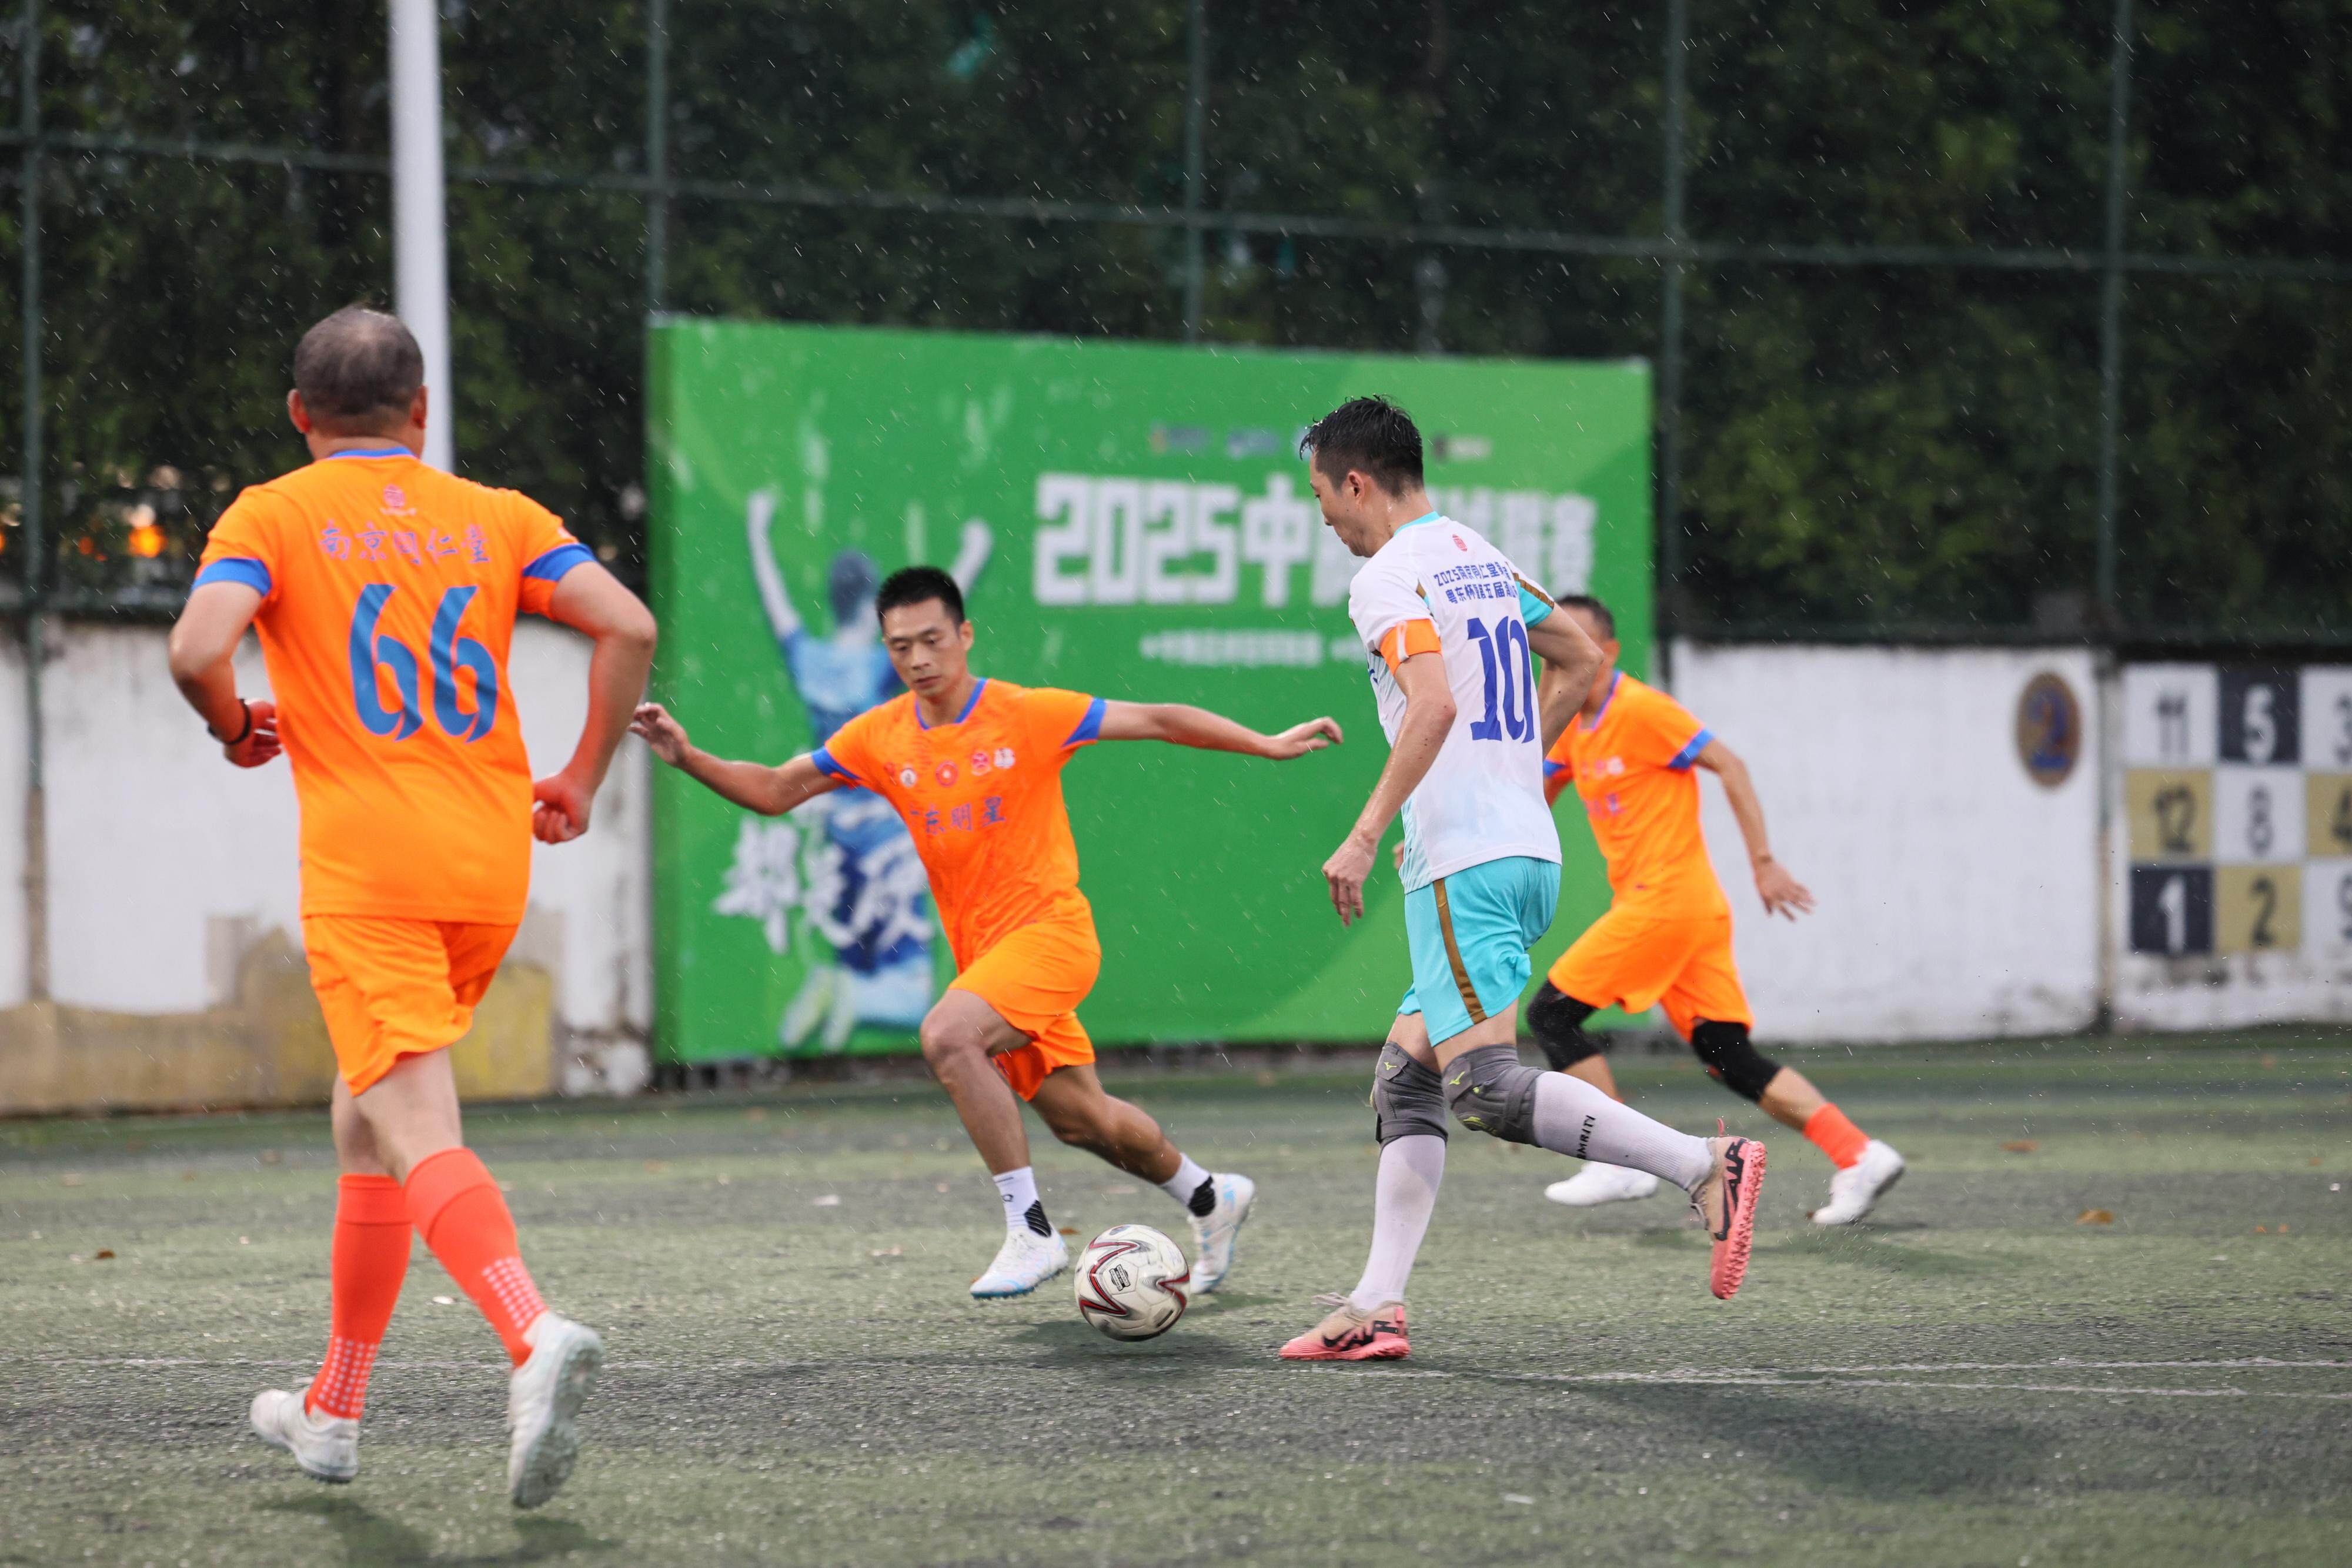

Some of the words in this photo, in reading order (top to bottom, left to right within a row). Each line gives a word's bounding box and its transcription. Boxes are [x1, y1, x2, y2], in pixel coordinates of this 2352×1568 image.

[349, 583, 499, 743] 66
[1467, 616, 1534, 743] 10
[2243, 684, 2277, 763] 5
[2245, 784, 2275, 857] 8
[2157, 876, 2186, 954] 1
[2248, 878, 2277, 947] 2
